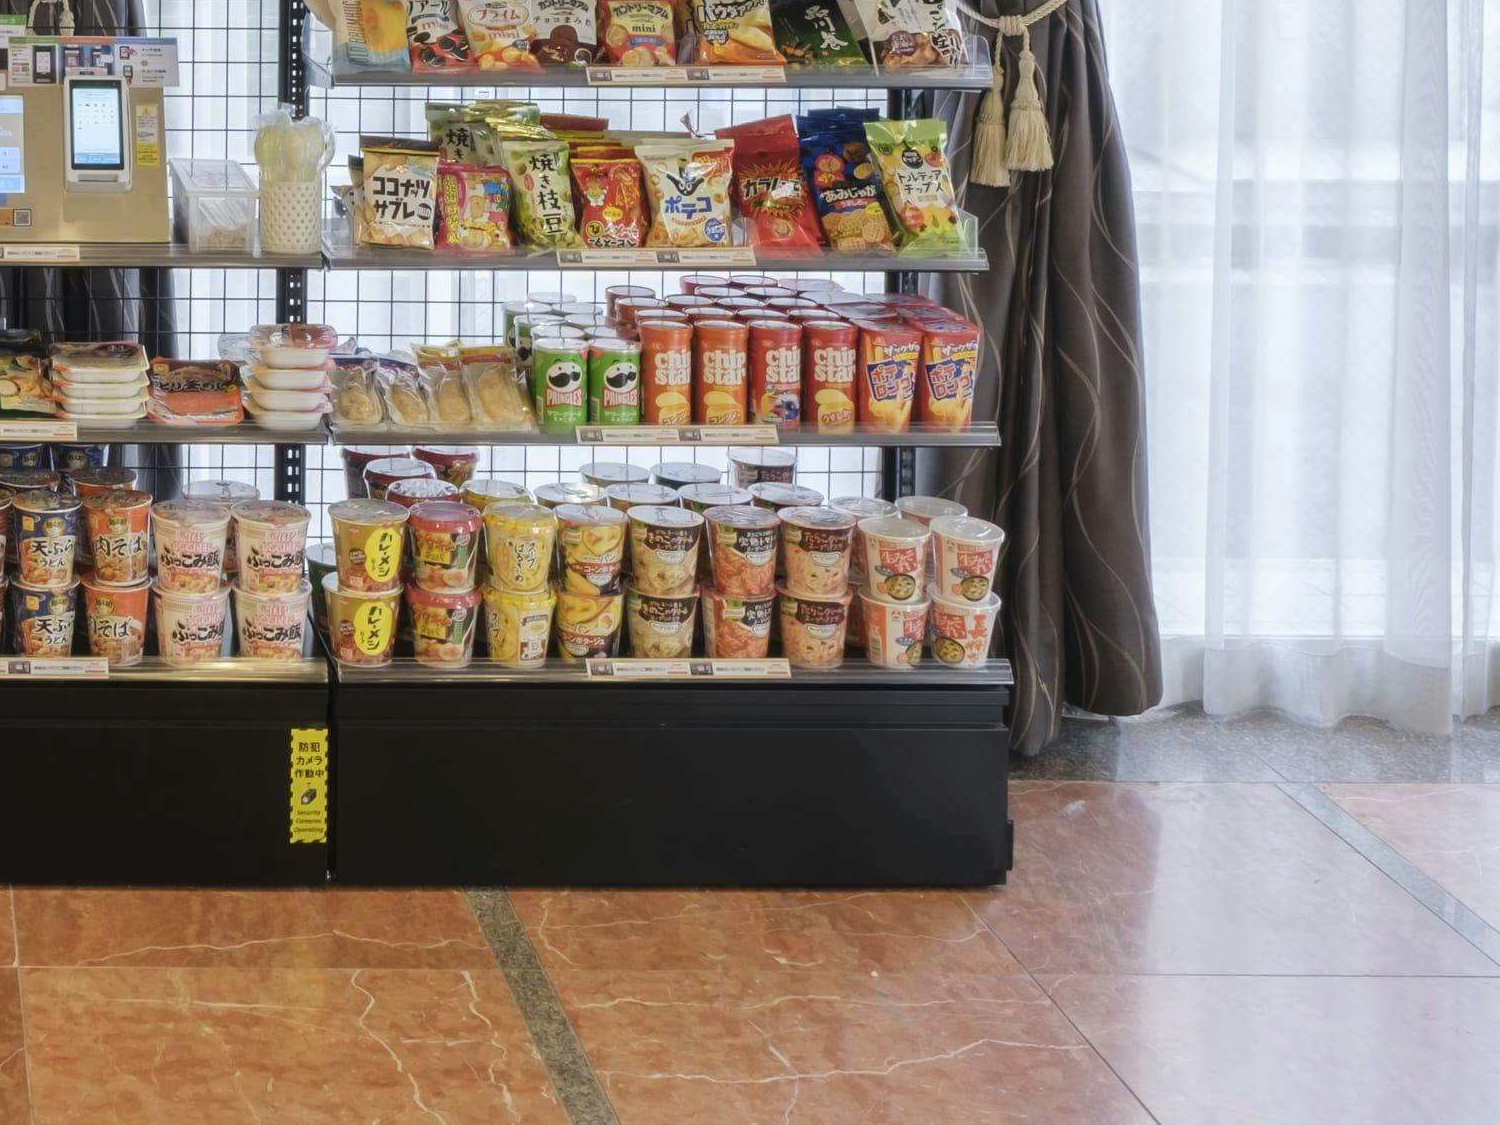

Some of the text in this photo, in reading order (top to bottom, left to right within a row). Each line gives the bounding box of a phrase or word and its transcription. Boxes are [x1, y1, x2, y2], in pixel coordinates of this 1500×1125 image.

[612, 2, 669, 20] カントリーマアム
[631, 24, 656, 33] mini
[372, 176, 431, 198] ココナッツ
[528, 154, 564, 235] 焼き枝豆
[824, 184, 877, 203] あみじゃが
[902, 182, 945, 194] チップス
[373, 198, 415, 220] サブレ
[664, 195, 712, 220] ポテコ
[703, 349, 747, 369] chip
[813, 347, 856, 367] chip
[703, 368, 747, 386] star
[813, 365, 856, 383] star
[870, 364, 898, 384] ポテ
[928, 363, 959, 383] ポテ
[546, 388, 583, 407] PRINGLES
[603, 388, 638, 407] PRINGLES
[31, 539, 75, 557] 天ぷら
[94, 537, 142, 558] 肉そば
[160, 543, 221, 569] ぶっこみ飯
[377, 531, 393, 578] カレーメシ
[40, 558, 67, 569] うどん
[366, 605, 384, 651] カレーメシ
[43, 633, 68, 645] うどん
[298, 742, 321, 753] 防犯
[296, 756, 323, 766] カメラ
[295, 769, 324, 779] 作動中
